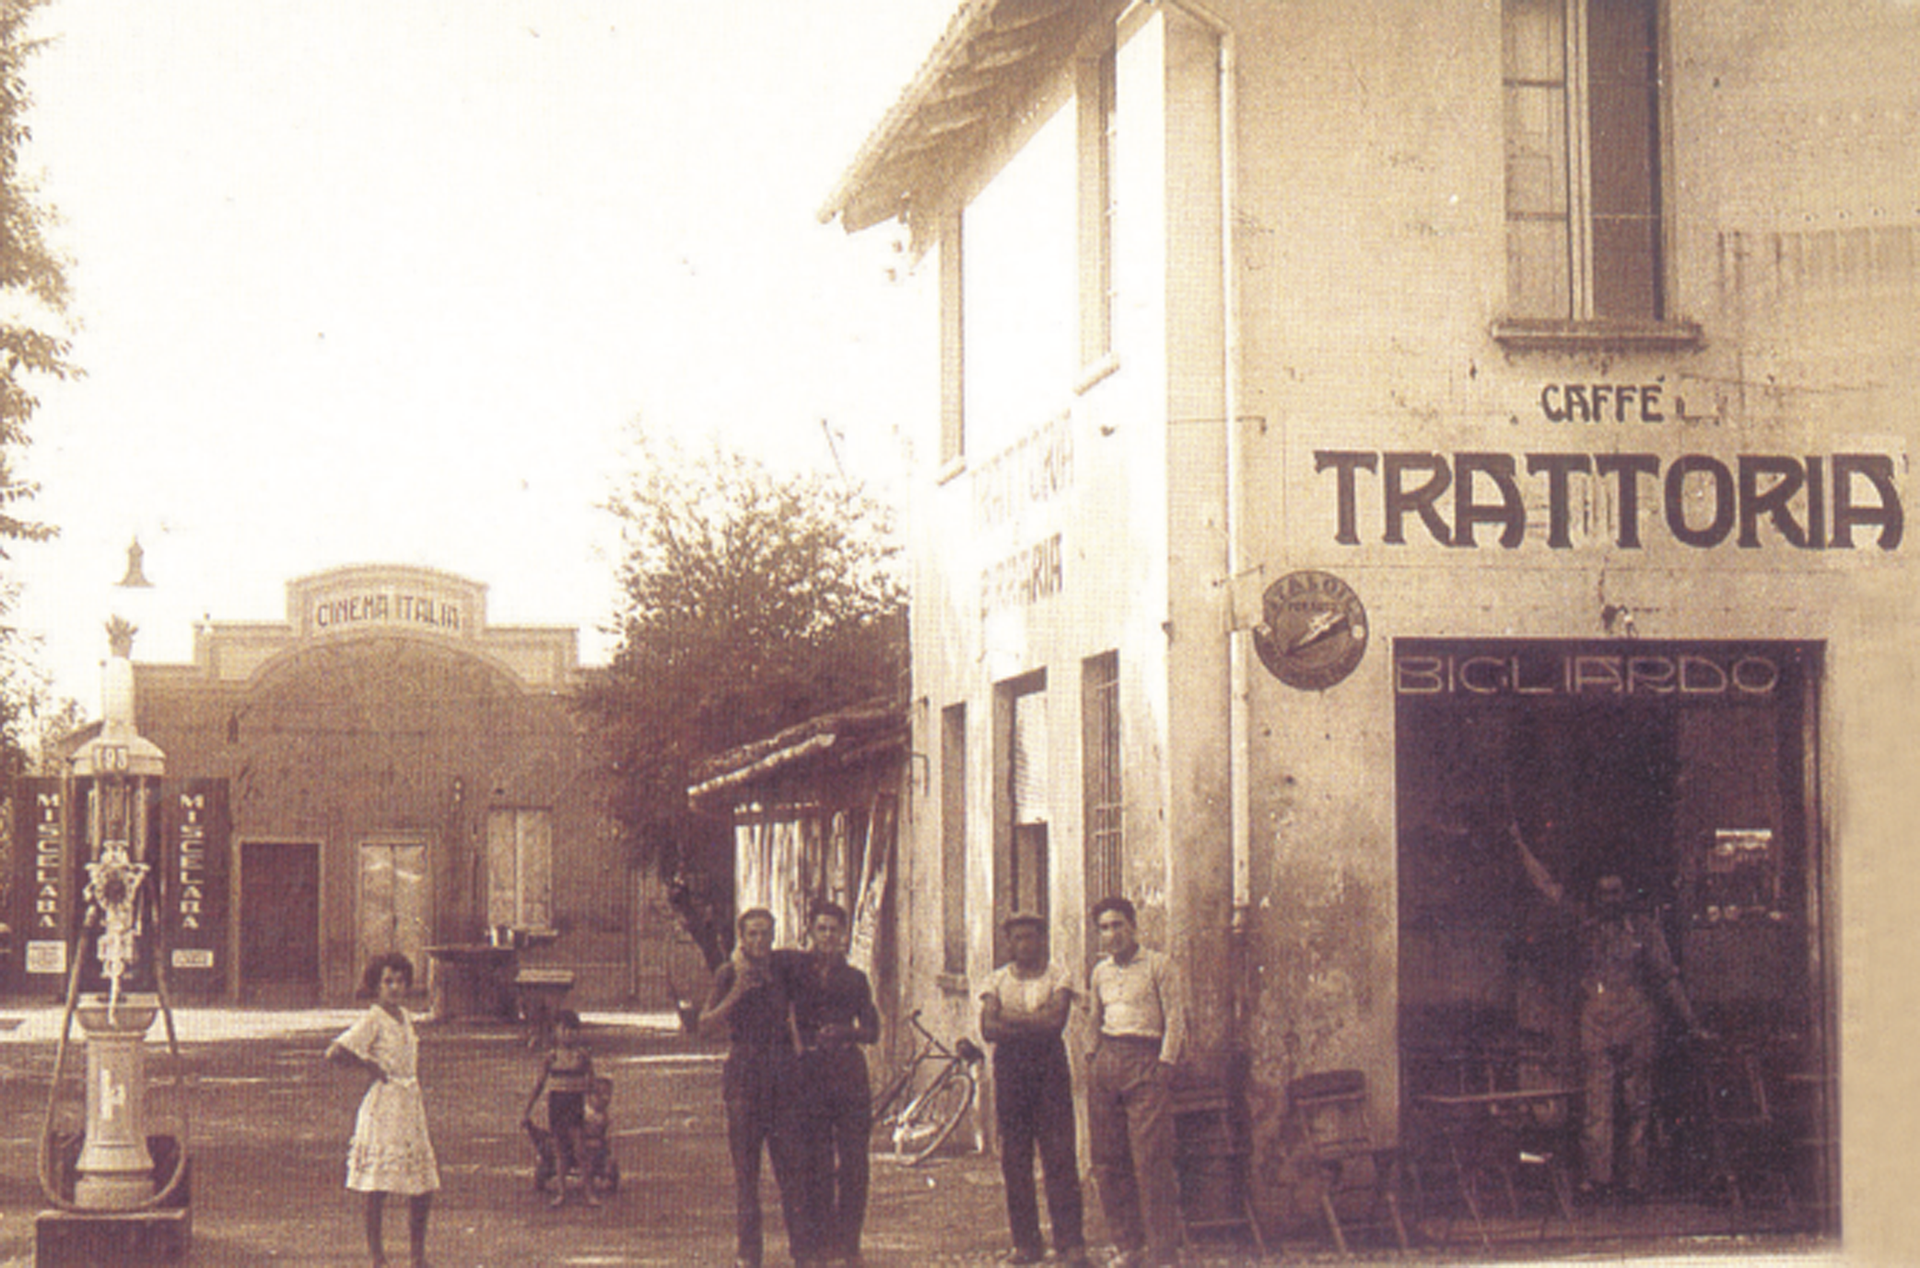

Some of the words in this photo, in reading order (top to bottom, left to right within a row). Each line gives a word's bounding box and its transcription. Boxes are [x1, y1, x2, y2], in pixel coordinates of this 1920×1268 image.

[1313, 450, 1904, 550] TRATTORIA
[318, 594, 388, 627] CINEMA
[395, 595, 460, 630] ITALIA
[1397, 655, 1779, 694] BIGLIARDO
